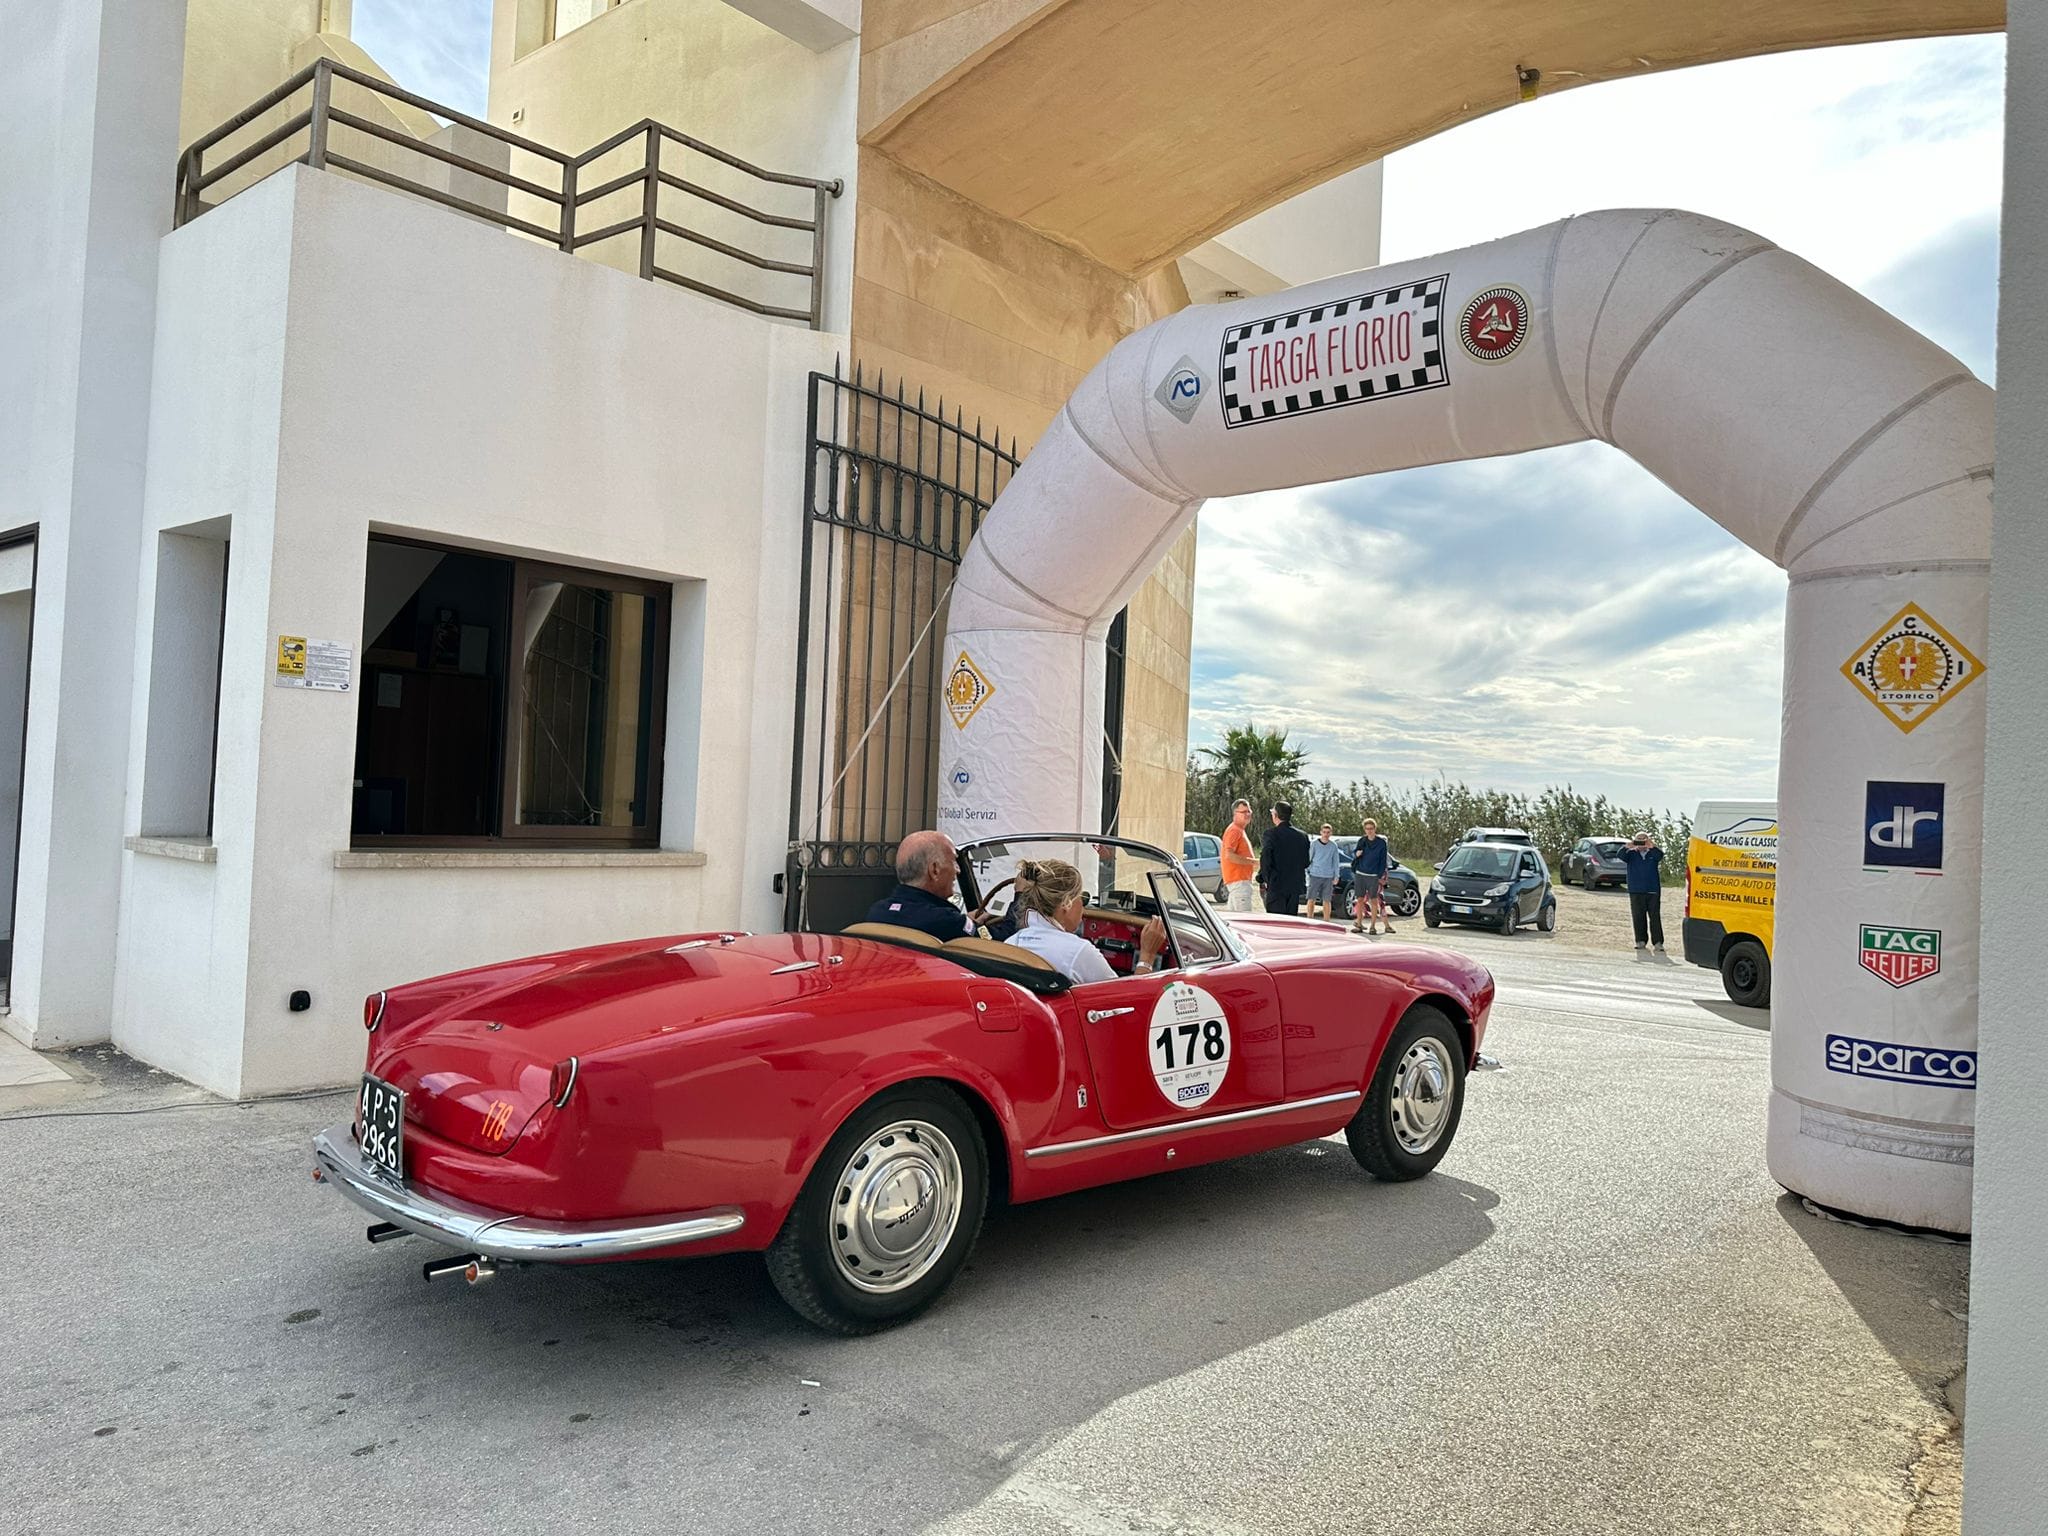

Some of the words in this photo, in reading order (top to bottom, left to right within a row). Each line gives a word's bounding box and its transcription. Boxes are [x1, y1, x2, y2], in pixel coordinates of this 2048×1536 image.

[1247, 331, 1320, 394] TARGA
[1326, 310, 1411, 378] FLORIO
[1171, 376, 1201, 400] ACI
[1881, 693, 1935, 701] STORICO
[965, 807, 997, 820] Servizi
[1719, 836, 1744, 846] RACING
[1868, 806, 1939, 849] dr
[1701, 876, 1740, 887] RESTAURO
[1741, 880, 1763, 889] AUTO
[1694, 890, 1742, 903] ASSISTENZA
[1743, 895, 1768, 906] MILLE
[1867, 929, 1932, 953] TAG
[1864, 952, 1935, 982] HEUER
[1156, 1020, 1225, 1070] 178
[1828, 1038, 1976, 1079] sparco
[481, 1100, 514, 1142] 178
[361, 1119, 397, 1169] 2966
